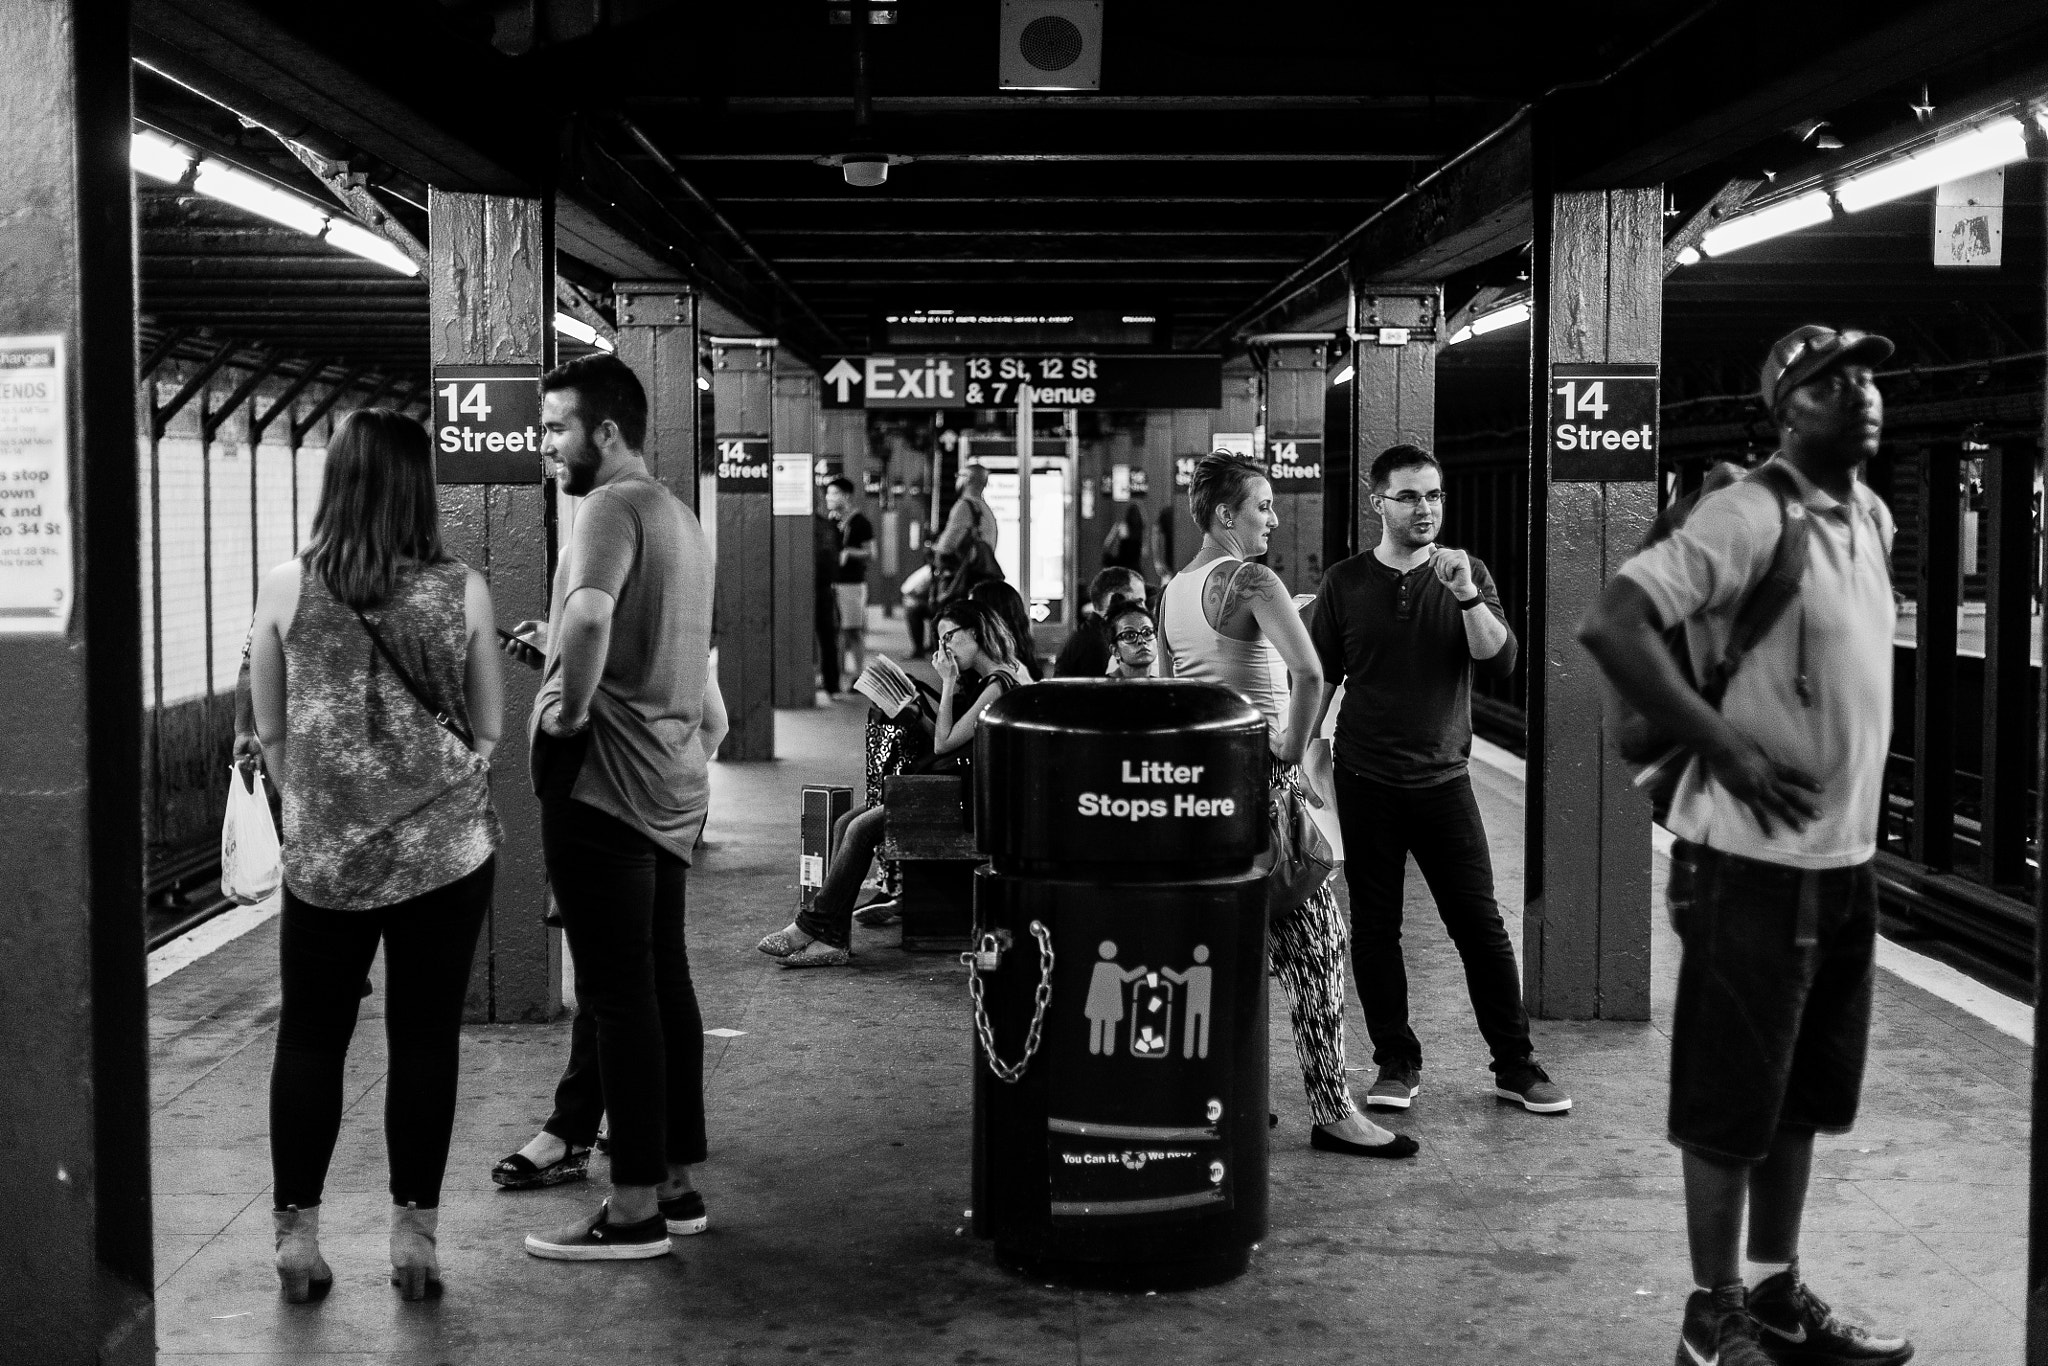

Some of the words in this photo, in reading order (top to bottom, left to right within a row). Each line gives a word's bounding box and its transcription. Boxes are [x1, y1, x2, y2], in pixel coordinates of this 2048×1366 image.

[0, 353, 48, 367] hanges
[966, 358, 992, 379] 13
[1000, 358, 1031, 382] St,
[1039, 358, 1064, 379] 12
[1071, 358, 1098, 379] St
[866, 358, 955, 398] Exit
[0, 383, 46, 399] ENDS
[966, 383, 984, 404] &
[991, 383, 1008, 404] 7
[1557, 381, 1609, 420] 14
[439, 383, 492, 422] 14
[440, 426, 537, 453] Street
[1556, 424, 1653, 451] Street
[718, 441, 749, 463] 14
[1271, 442, 1299, 463] 14
[12, 469, 49, 483] stop
[718, 463, 768, 479] Street
[1271, 463, 1322, 479] Street
[11, 504, 42, 517] and
[18, 522, 39, 536] 34
[45, 522, 61, 536] St
[1122, 760, 1204, 783] Litter
[1078, 793, 1168, 822] Stops
[1174, 794, 1235, 817] Here
[1062, 1154, 1081, 1164] You
[1084, 1154, 1106, 1164] Can
